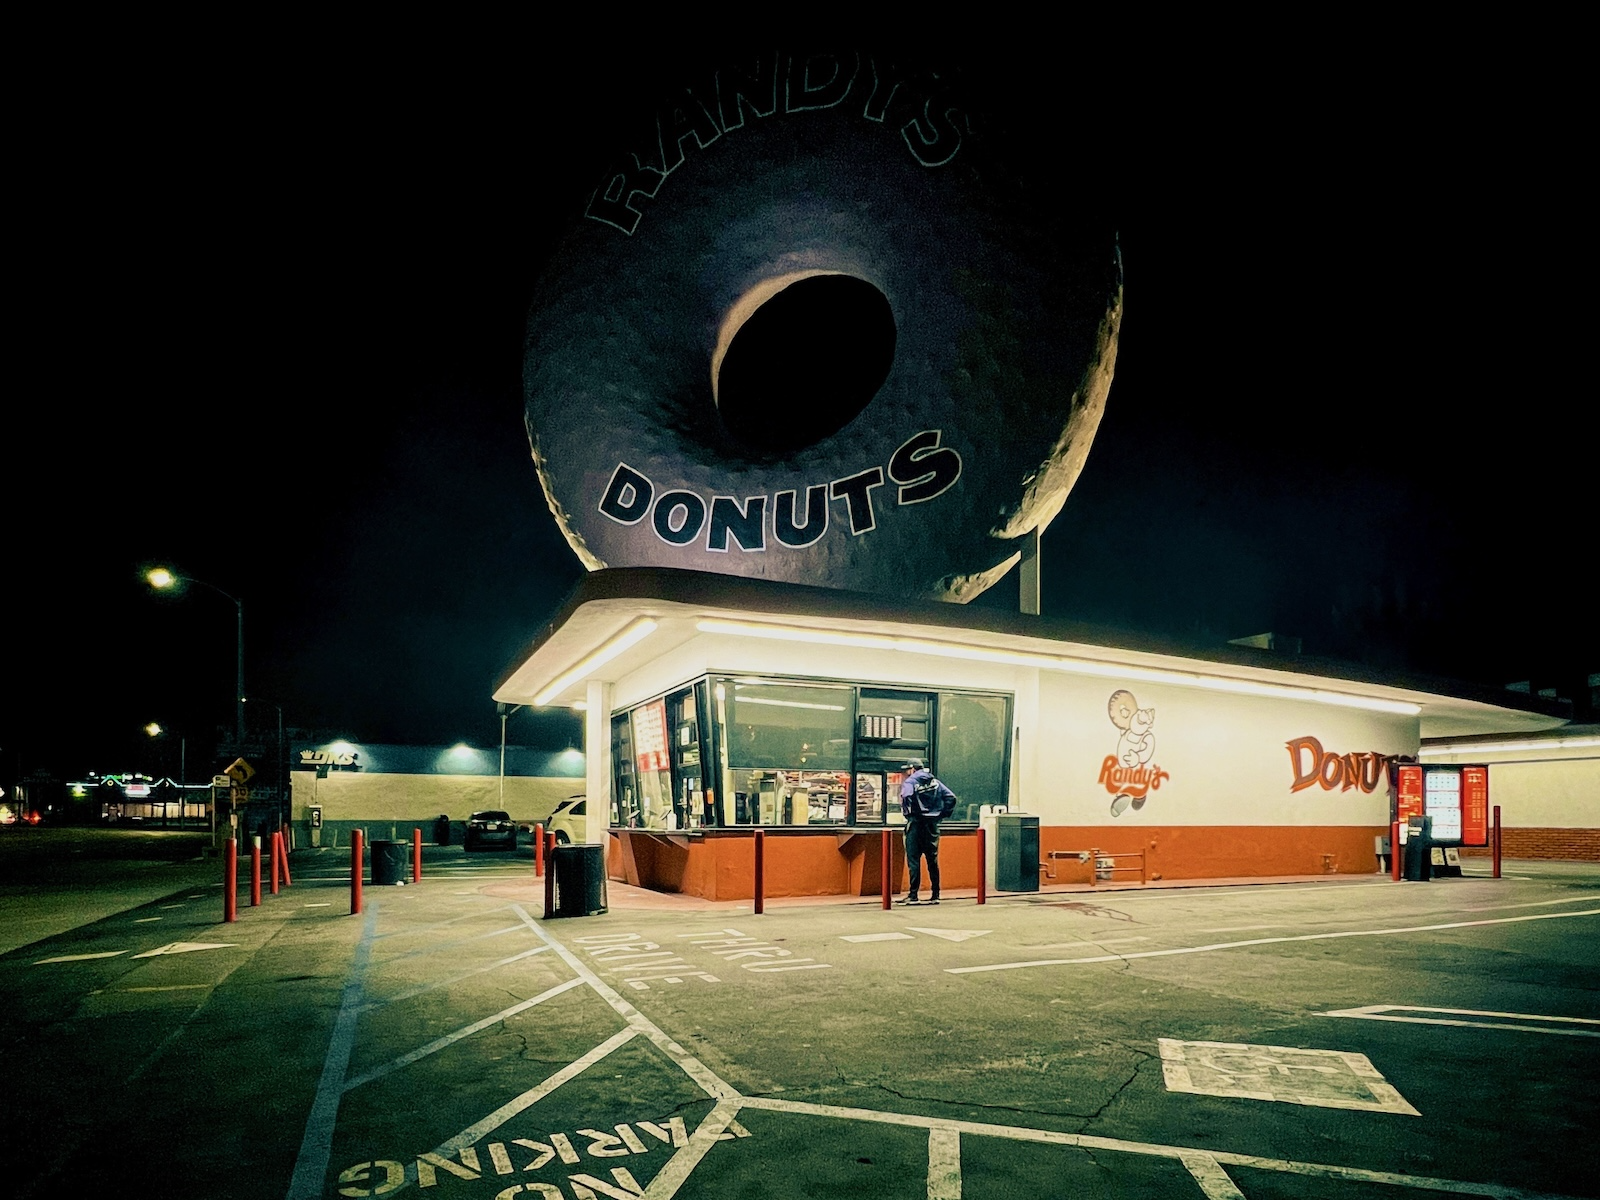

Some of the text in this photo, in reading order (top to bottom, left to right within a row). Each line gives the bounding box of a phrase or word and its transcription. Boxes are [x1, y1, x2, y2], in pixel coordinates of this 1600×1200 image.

[598, 430, 962, 552] DONUTS
[1097, 754, 1169, 798] Randy's
[573, 933, 721, 990] DRIVE
[676, 929, 832, 973] THRU
[338, 1111, 752, 1197] PARKING
